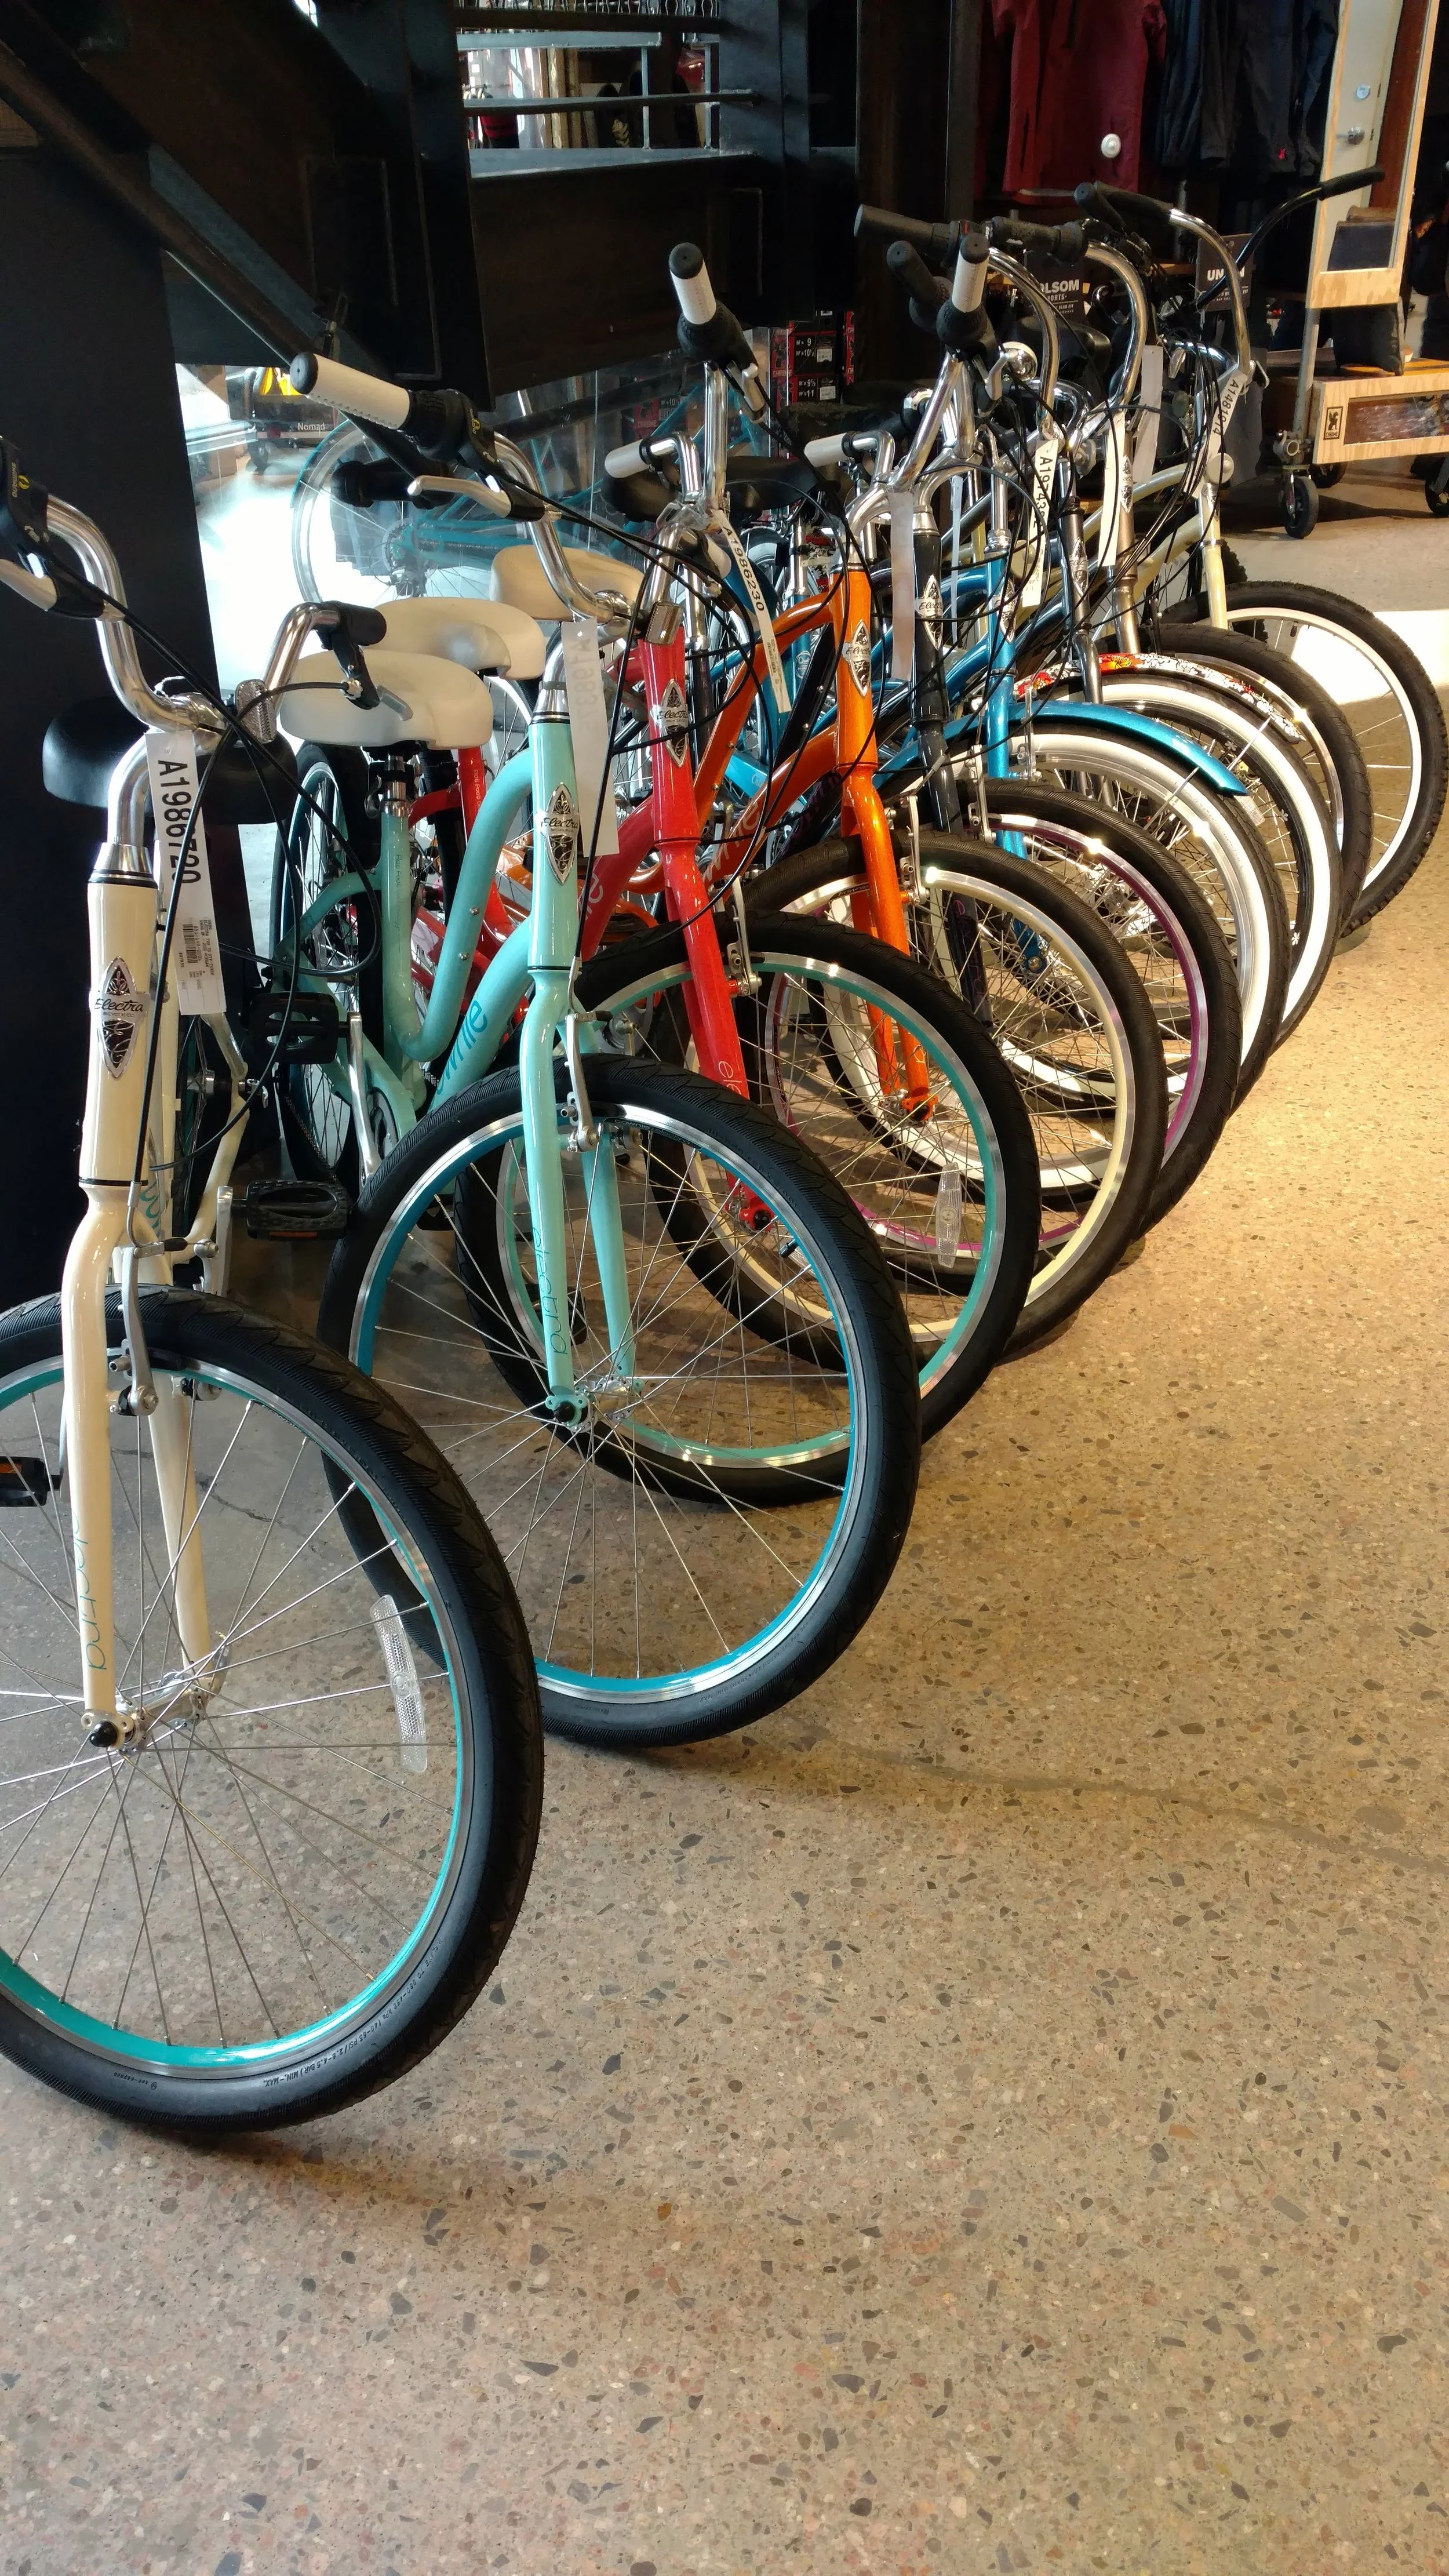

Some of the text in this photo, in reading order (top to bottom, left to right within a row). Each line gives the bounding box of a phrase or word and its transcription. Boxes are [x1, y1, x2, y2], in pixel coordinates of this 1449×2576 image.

[1040, 279, 1079, 294] LSOM
[297, 422, 326, 431] Nomad
[723, 526, 764, 612] A1986230
[158, 759, 202, 885] A1986720
[94, 998, 144, 1012] Electra
[533, 1227, 568, 1355] electra
